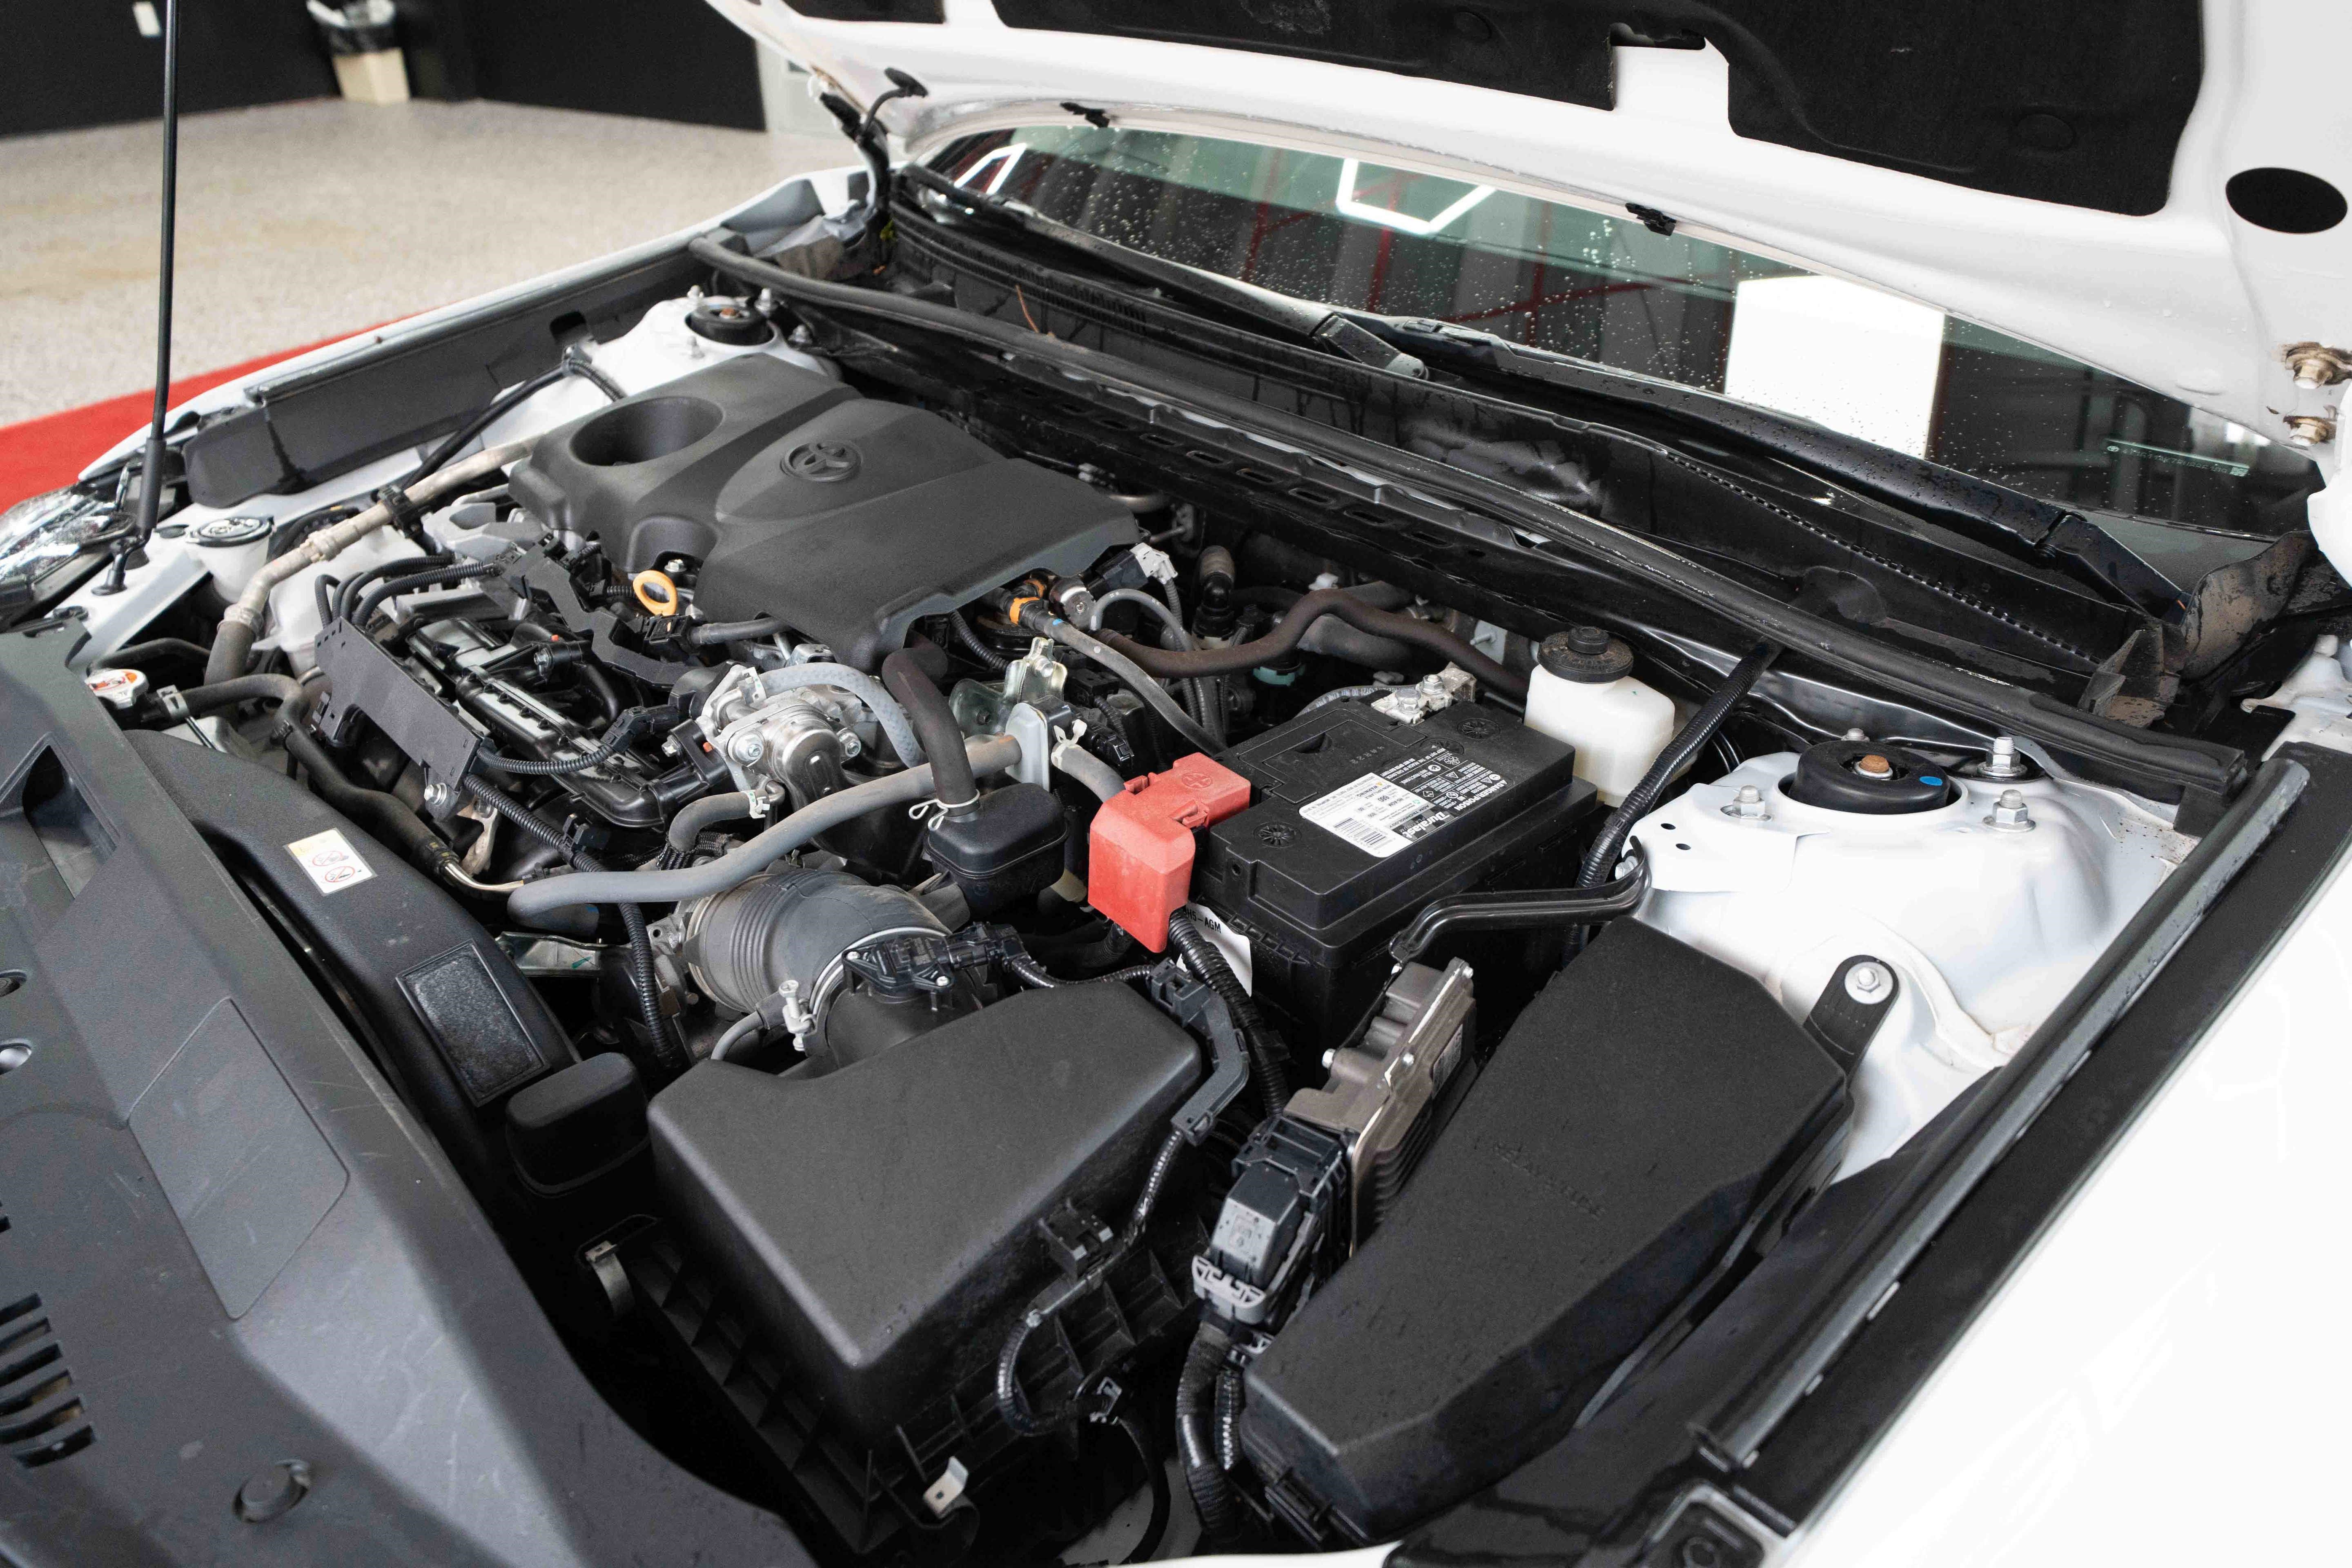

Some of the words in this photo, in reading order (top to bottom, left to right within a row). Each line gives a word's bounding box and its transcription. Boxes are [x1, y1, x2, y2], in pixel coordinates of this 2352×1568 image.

[1454, 783, 1503, 810] DANGER/POISON
[1390, 811, 1419, 828] TECHNOLOGY
[1399, 817, 1426, 832] PLATINUM
[1403, 812, 1450, 838] Duralast
